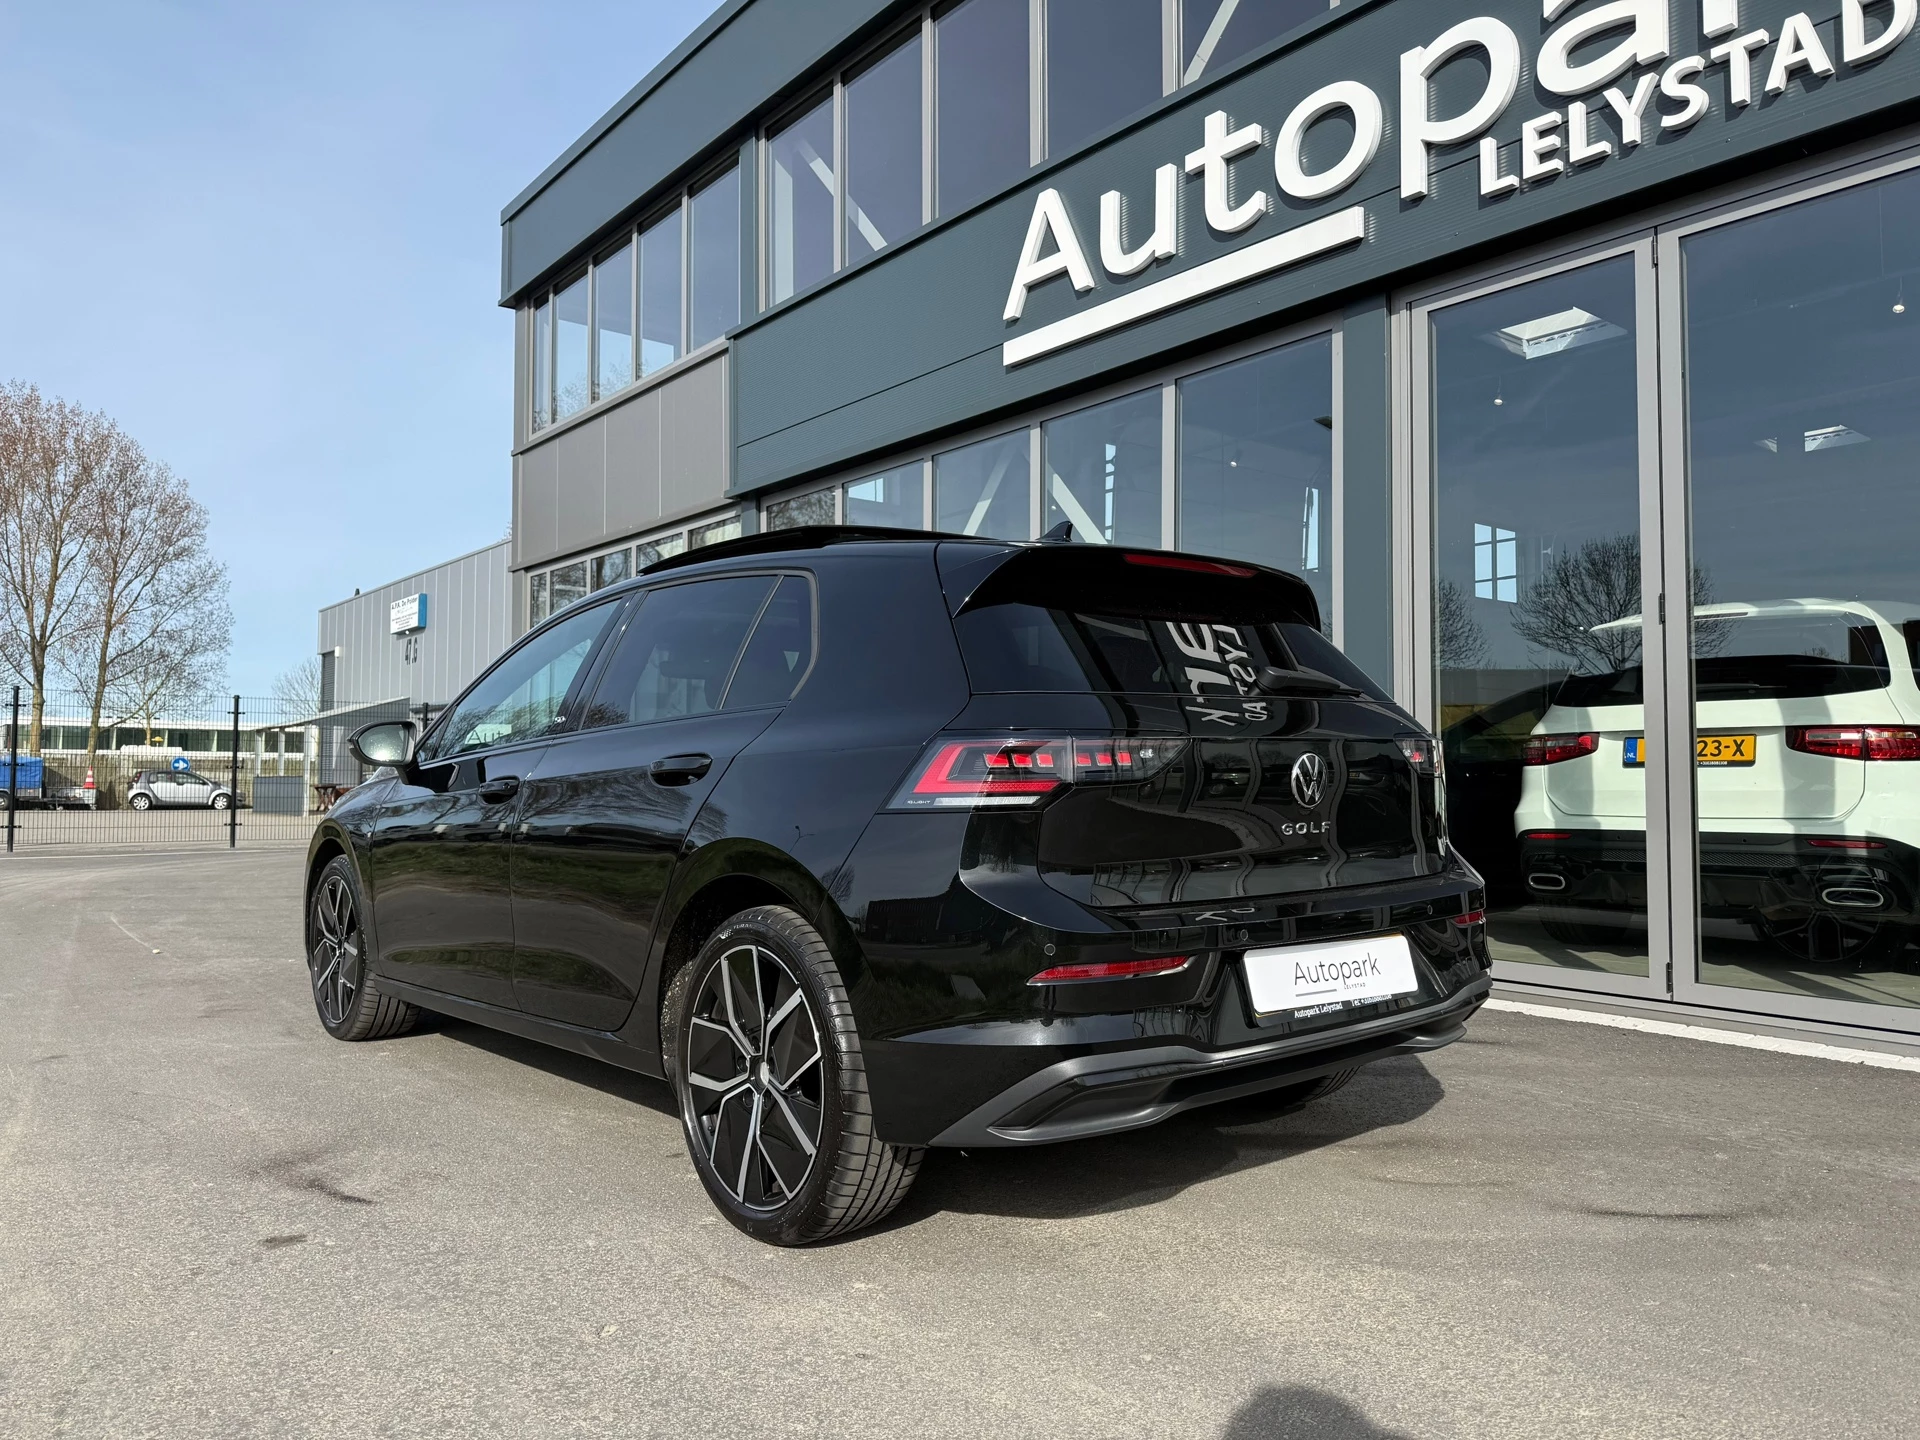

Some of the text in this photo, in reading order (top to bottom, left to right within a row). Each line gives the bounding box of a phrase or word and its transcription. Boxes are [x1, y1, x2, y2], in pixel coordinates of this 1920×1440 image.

[1480, 0, 1918, 199] LELYSTAD
[1281, 821, 1331, 836] GOLF
[1294, 952, 1381, 985] Autopark
[1343, 982, 1366, 990] LELYSTAD
[1294, 1005, 1320, 1019] Autopark
[1320, 1002, 1343, 1014] Lelystad
